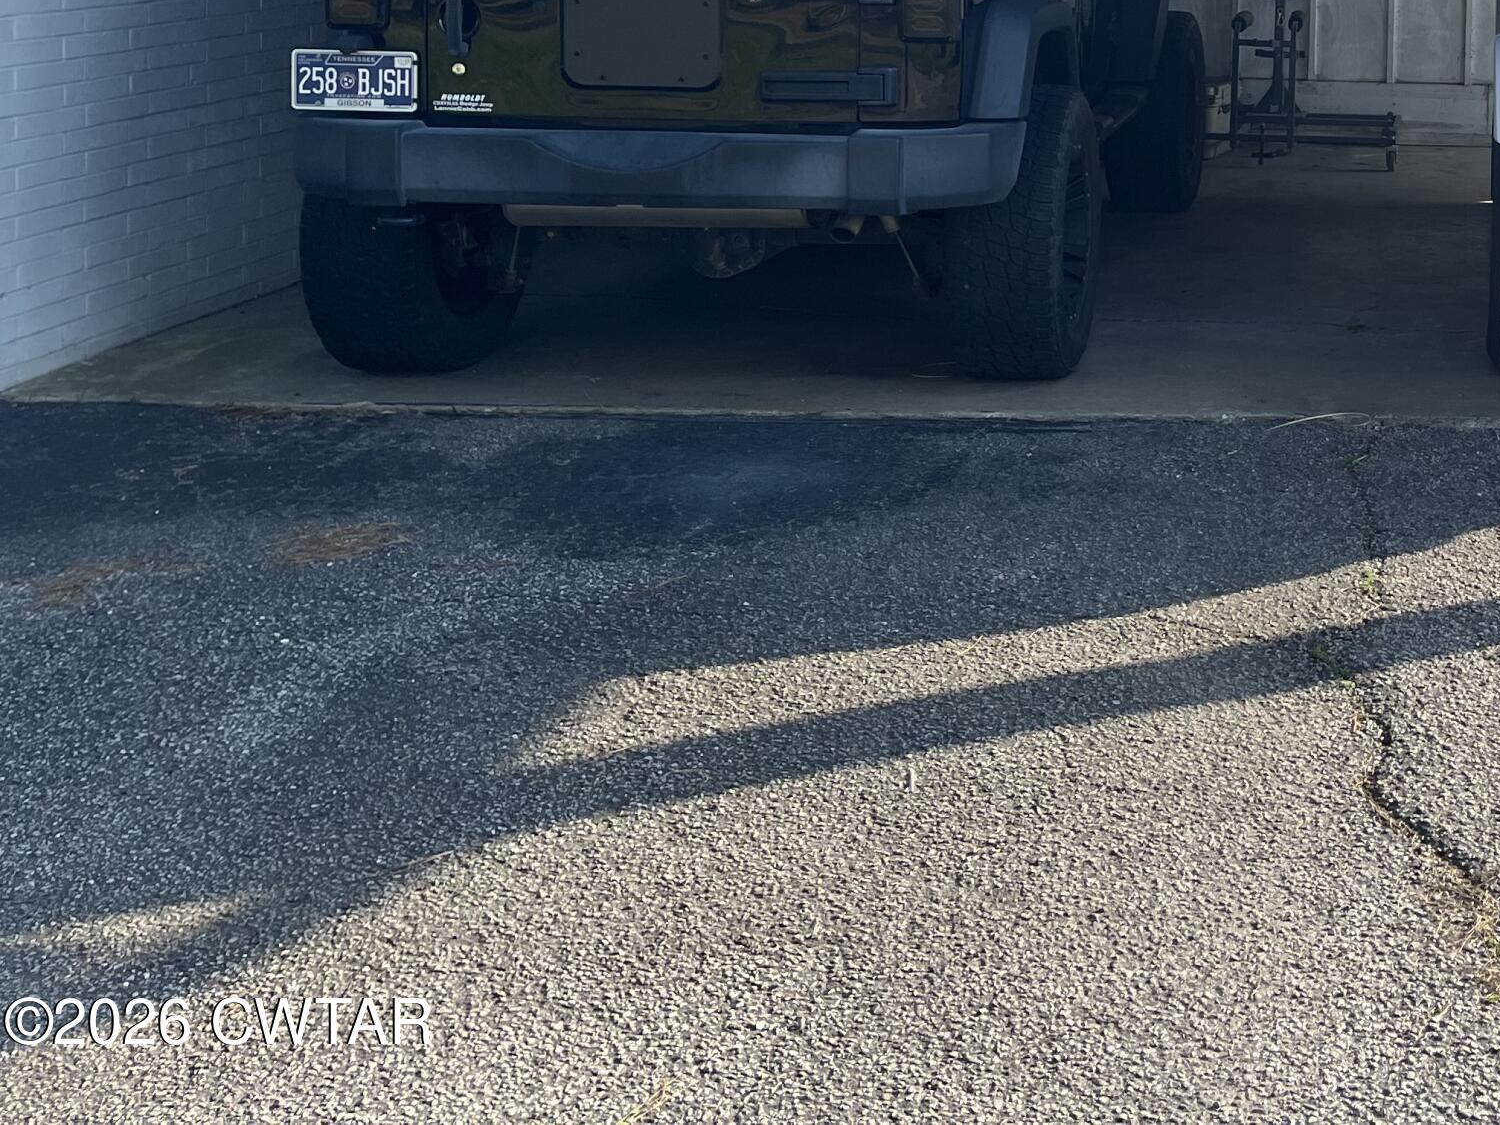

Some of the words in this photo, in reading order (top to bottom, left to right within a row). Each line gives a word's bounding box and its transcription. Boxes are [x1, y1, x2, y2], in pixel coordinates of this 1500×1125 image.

[332, 55, 376, 63] TENNESSEE
[298, 67, 338, 94] 258
[357, 68, 410, 96] BJSH
[440, 93, 485, 102] HUMBOLDT
[336, 99, 372, 107] GIBSON
